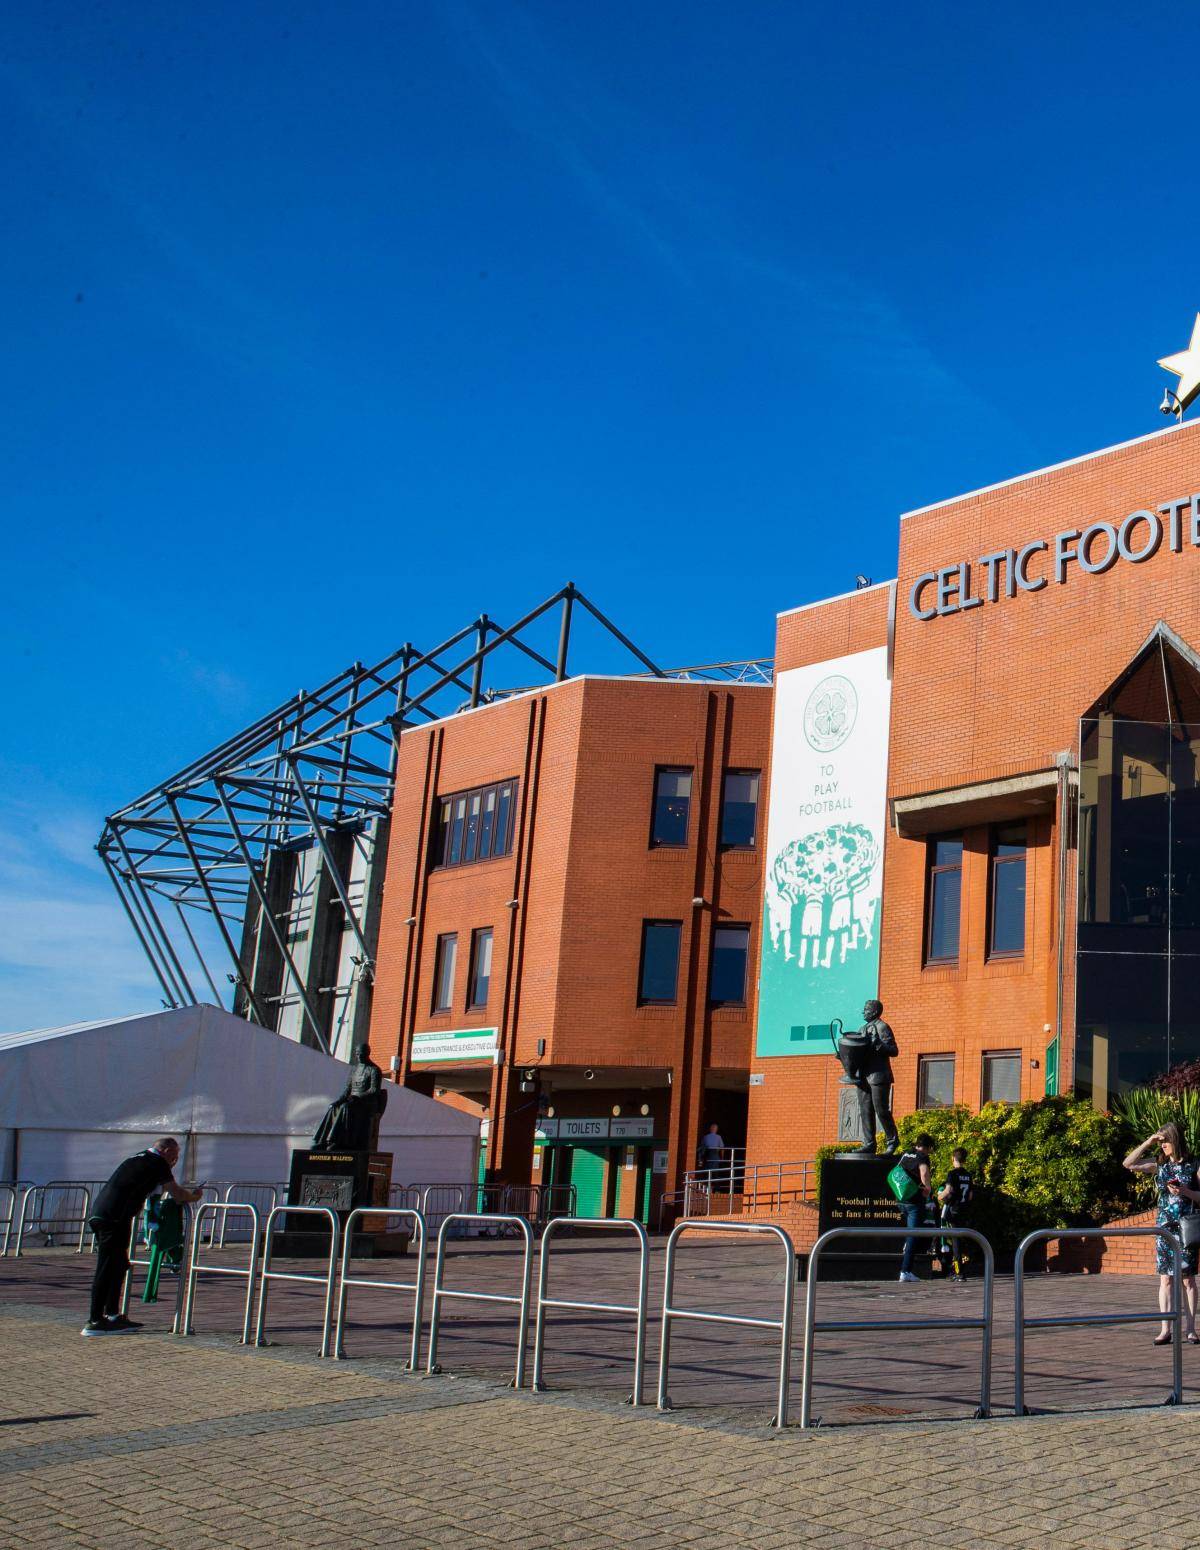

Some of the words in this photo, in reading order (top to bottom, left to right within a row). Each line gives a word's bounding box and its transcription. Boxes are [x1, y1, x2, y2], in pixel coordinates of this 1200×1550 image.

[908, 540, 1047, 620] CELTIC
[819, 764, 834, 777] TO
[814, 781, 839, 796] PLAY
[799, 797, 853, 817] FOOTBALL
[566, 1122, 601, 1134] TOILETS
[959, 1183, 970, 1203] 7
[836, 1196, 870, 1206] "Football
[831, 1209, 843, 1218] the
[846, 1209, 862, 1218] fans
[864, 1209, 871, 1218] is
